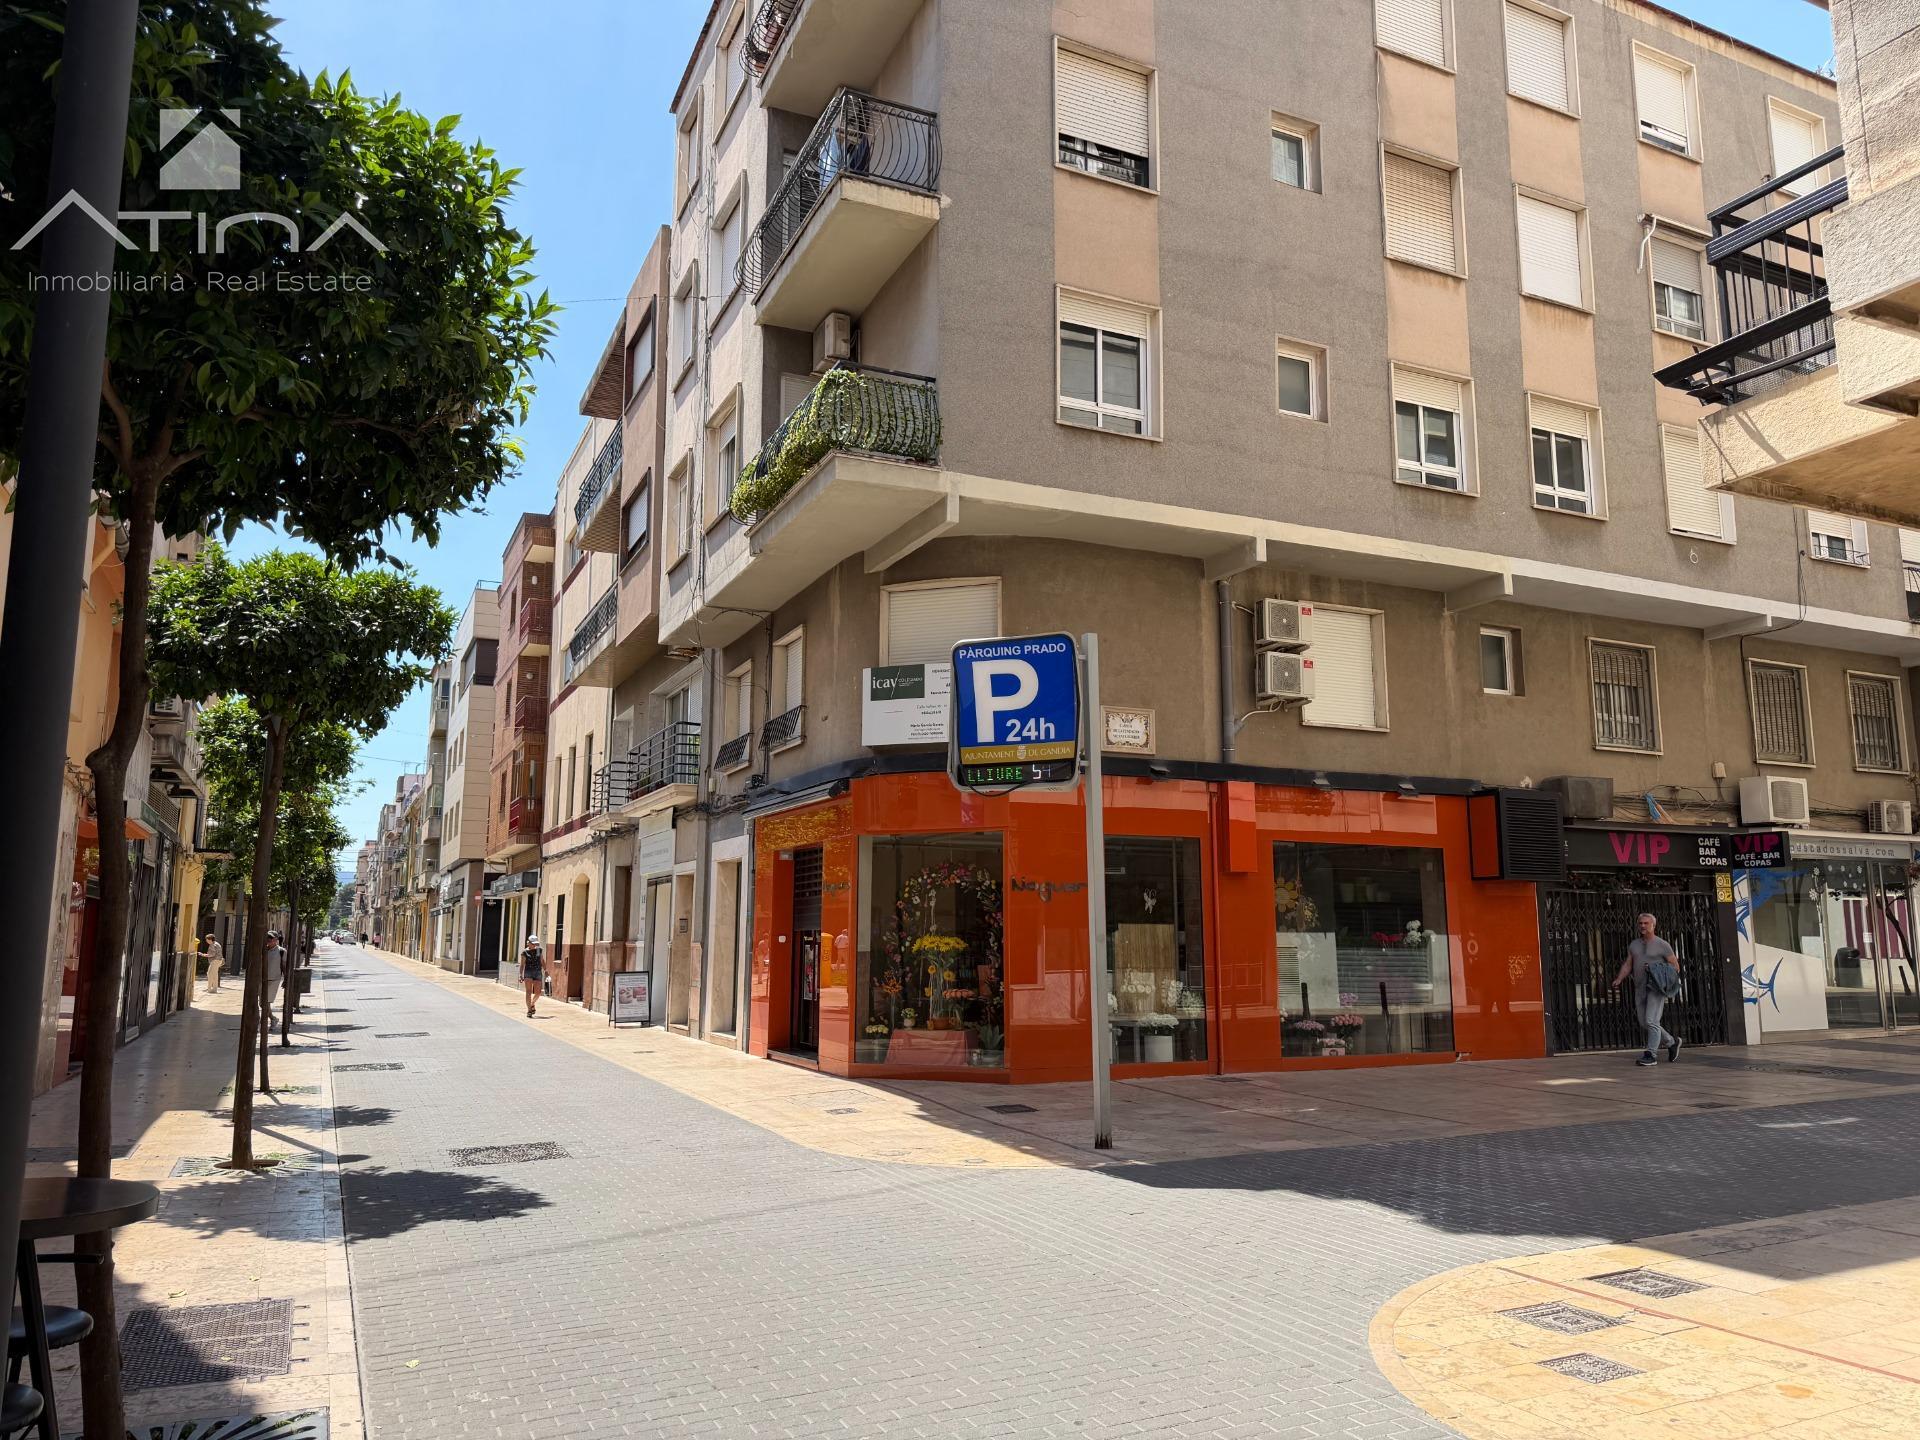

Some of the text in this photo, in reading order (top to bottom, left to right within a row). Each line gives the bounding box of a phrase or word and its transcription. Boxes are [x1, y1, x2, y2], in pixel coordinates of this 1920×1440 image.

[959, 642, 1066, 659] PÀRQUING PRADO
[972, 658, 1039, 743] P
[1005, 717, 1056, 742] 24h
[964, 746, 1072, 761] AJUNTAMENT DE GANDIA
[967, 766, 1023, 782] LLIURE
[1609, 832, 1670, 865] VIP
[1698, 837, 1720, 847] CAFÉ
[1734, 834, 1779, 853] VIP
[1699, 847, 1717, 857] BAR
[1734, 851, 1780, 862] CAFÉ BAR
[1699, 857, 1728, 867] COPAS
[1744, 859, 1772, 867] COPAS
